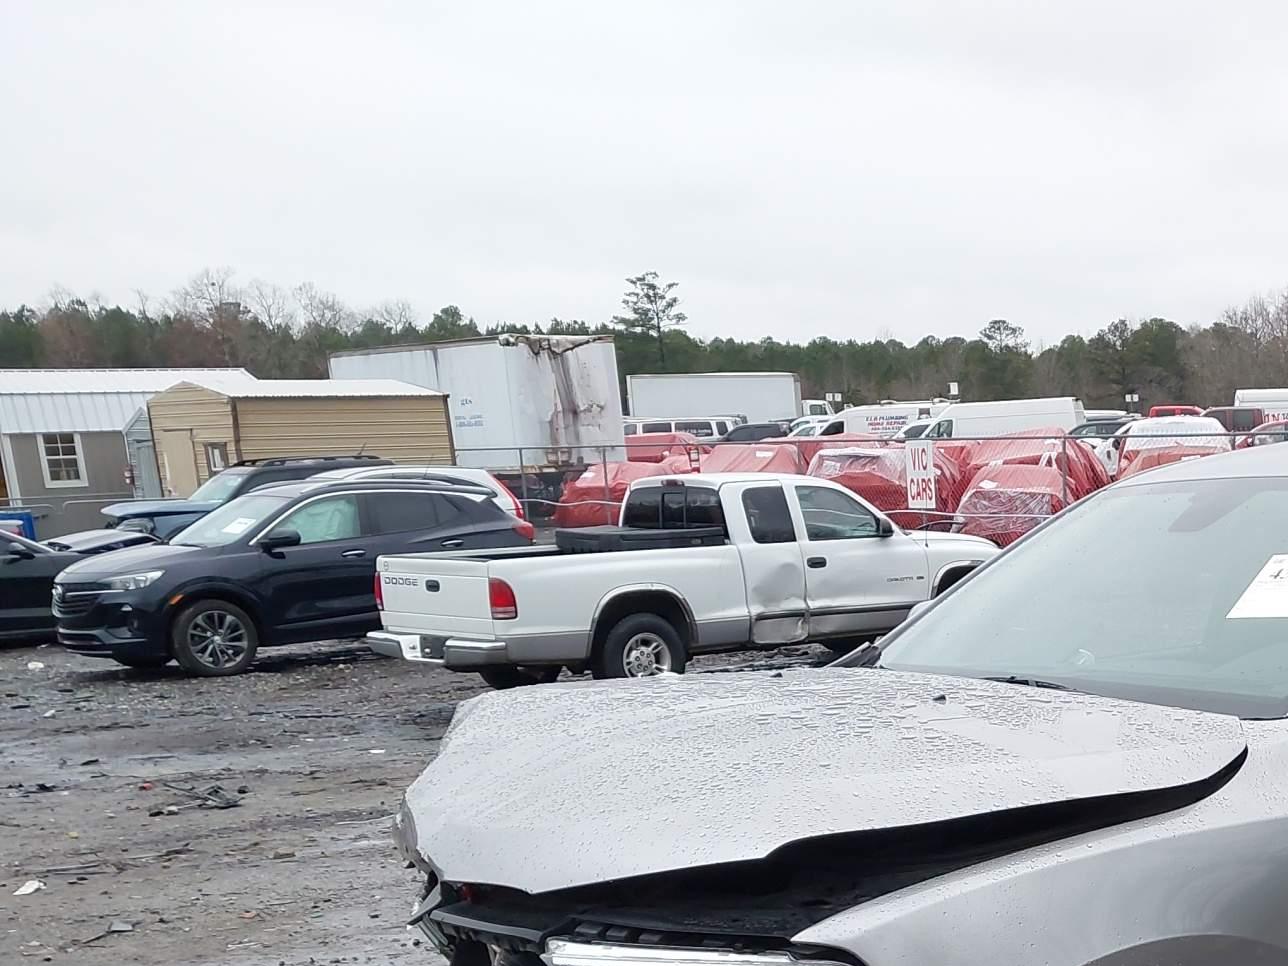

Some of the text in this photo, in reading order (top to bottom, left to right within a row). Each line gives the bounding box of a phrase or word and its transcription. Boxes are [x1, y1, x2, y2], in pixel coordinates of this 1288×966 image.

[910, 447, 928, 471] VIC
[909, 478, 933, 501] CARS
[384, 576, 419, 587] DODGE
